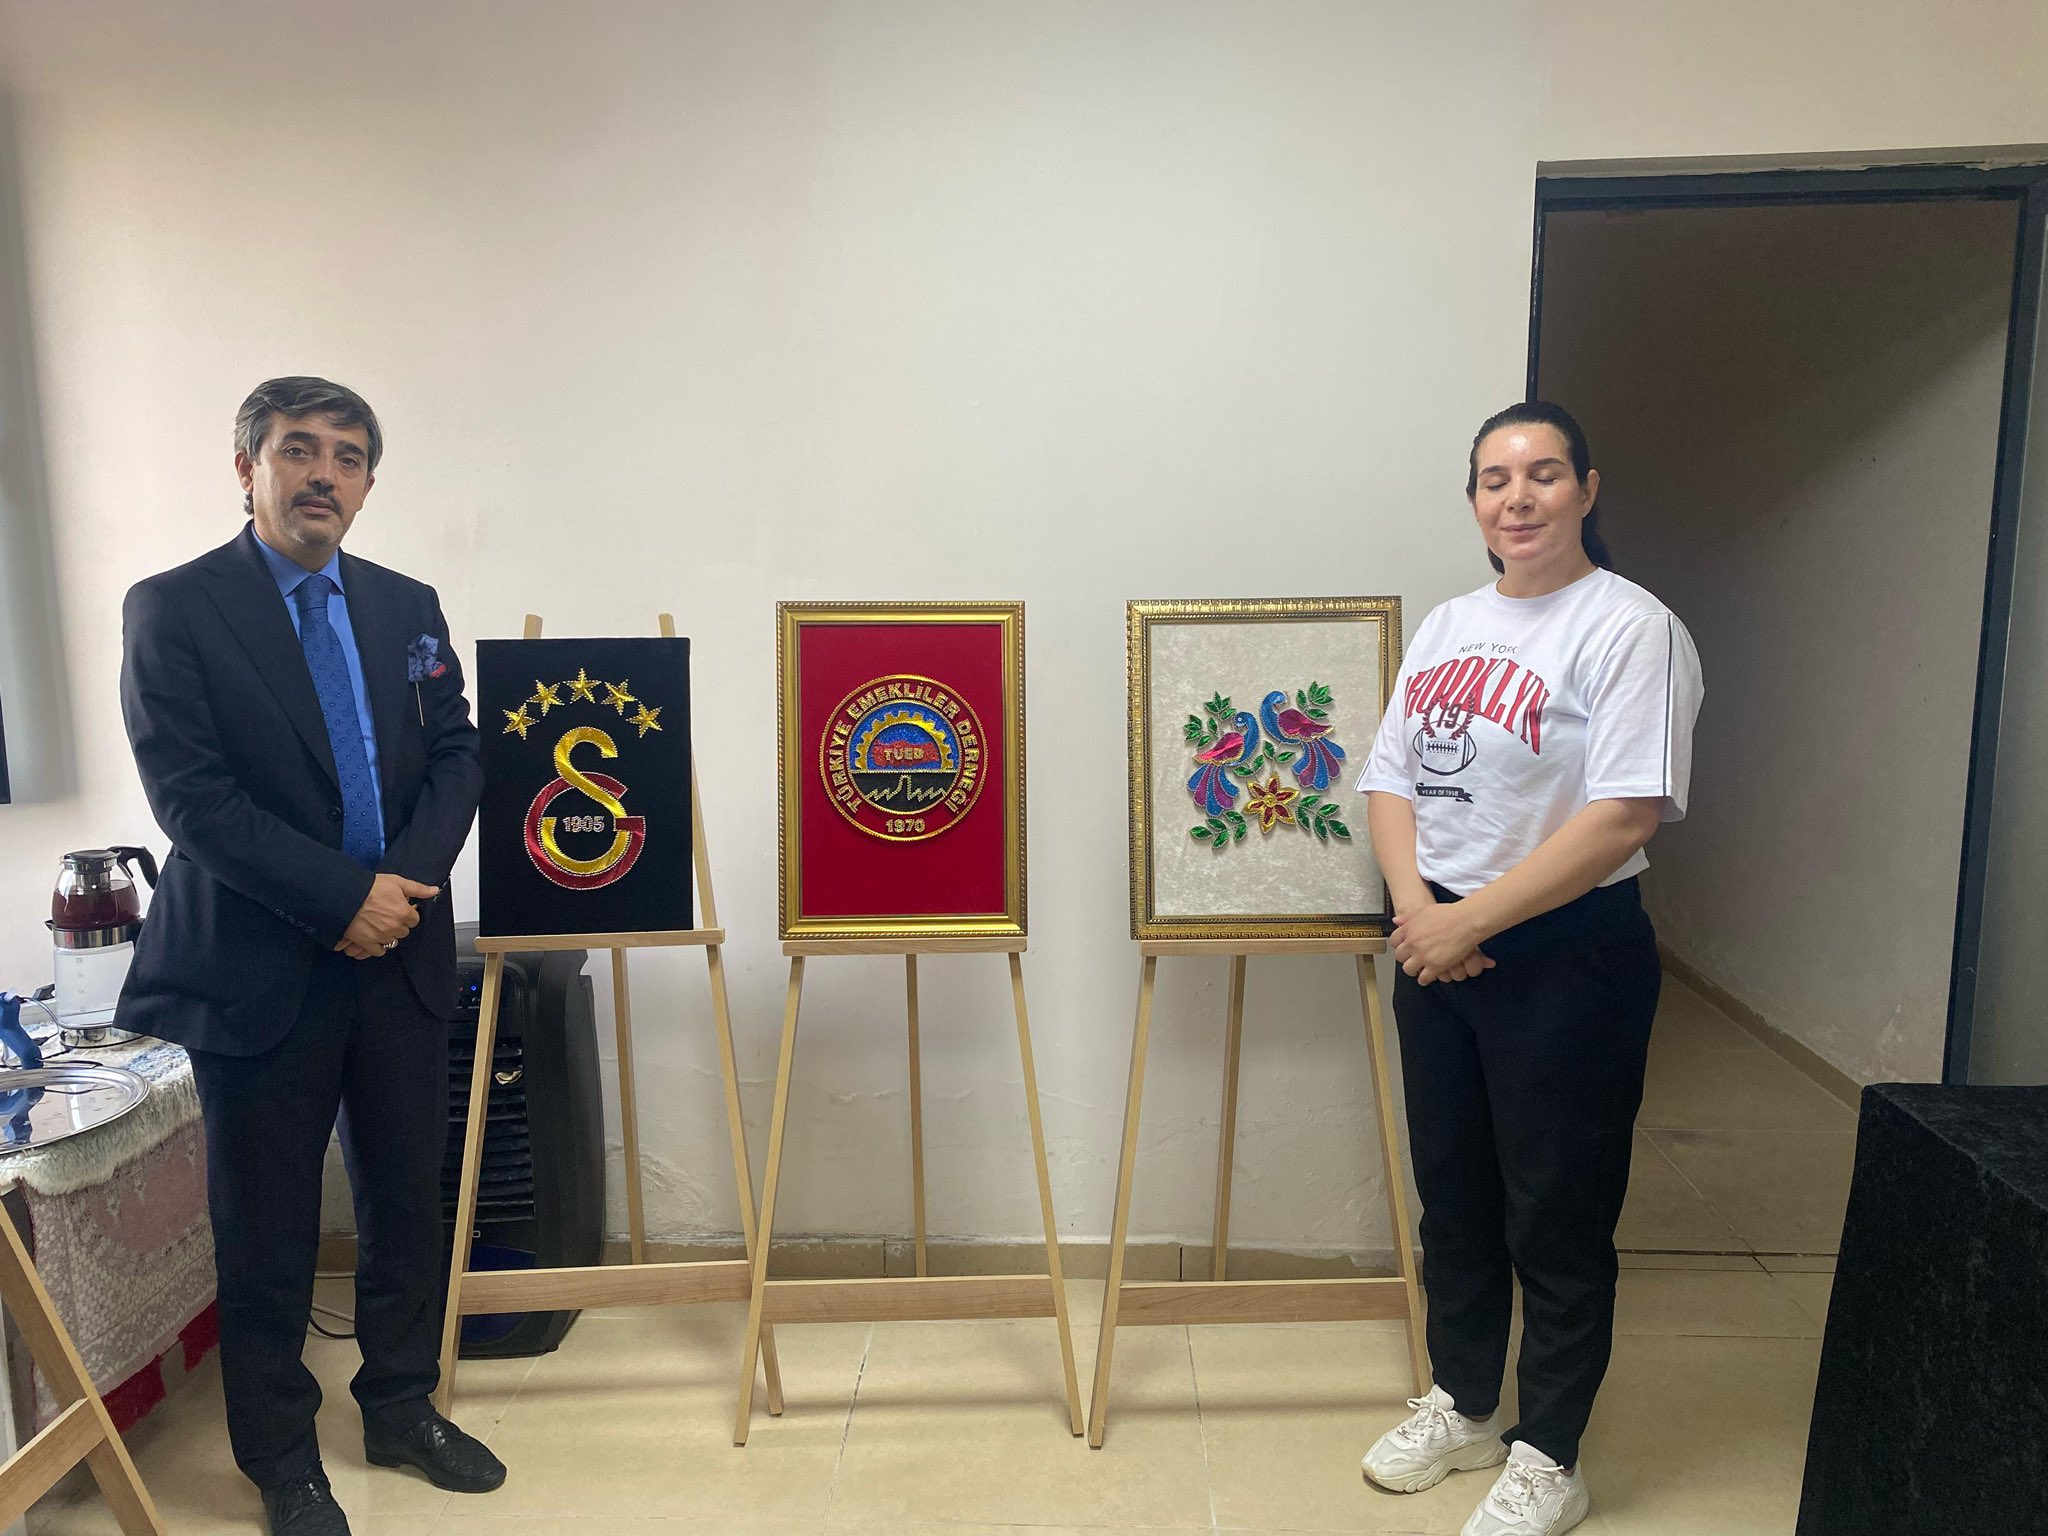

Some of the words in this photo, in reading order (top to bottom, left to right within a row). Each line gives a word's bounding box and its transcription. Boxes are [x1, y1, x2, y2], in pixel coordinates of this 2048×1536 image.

[1459, 642, 1486, 654] NEW
[1491, 642, 1518, 654] YORK
[1404, 656, 1550, 755] ROOKLYN
[1436, 702, 1462, 729] 19
[826, 720, 862, 813] TÜRKİYE
[846, 682, 960, 720] EMEKLİLER
[563, 815, 605, 833] 1905
[886, 818, 926, 833] 1970
